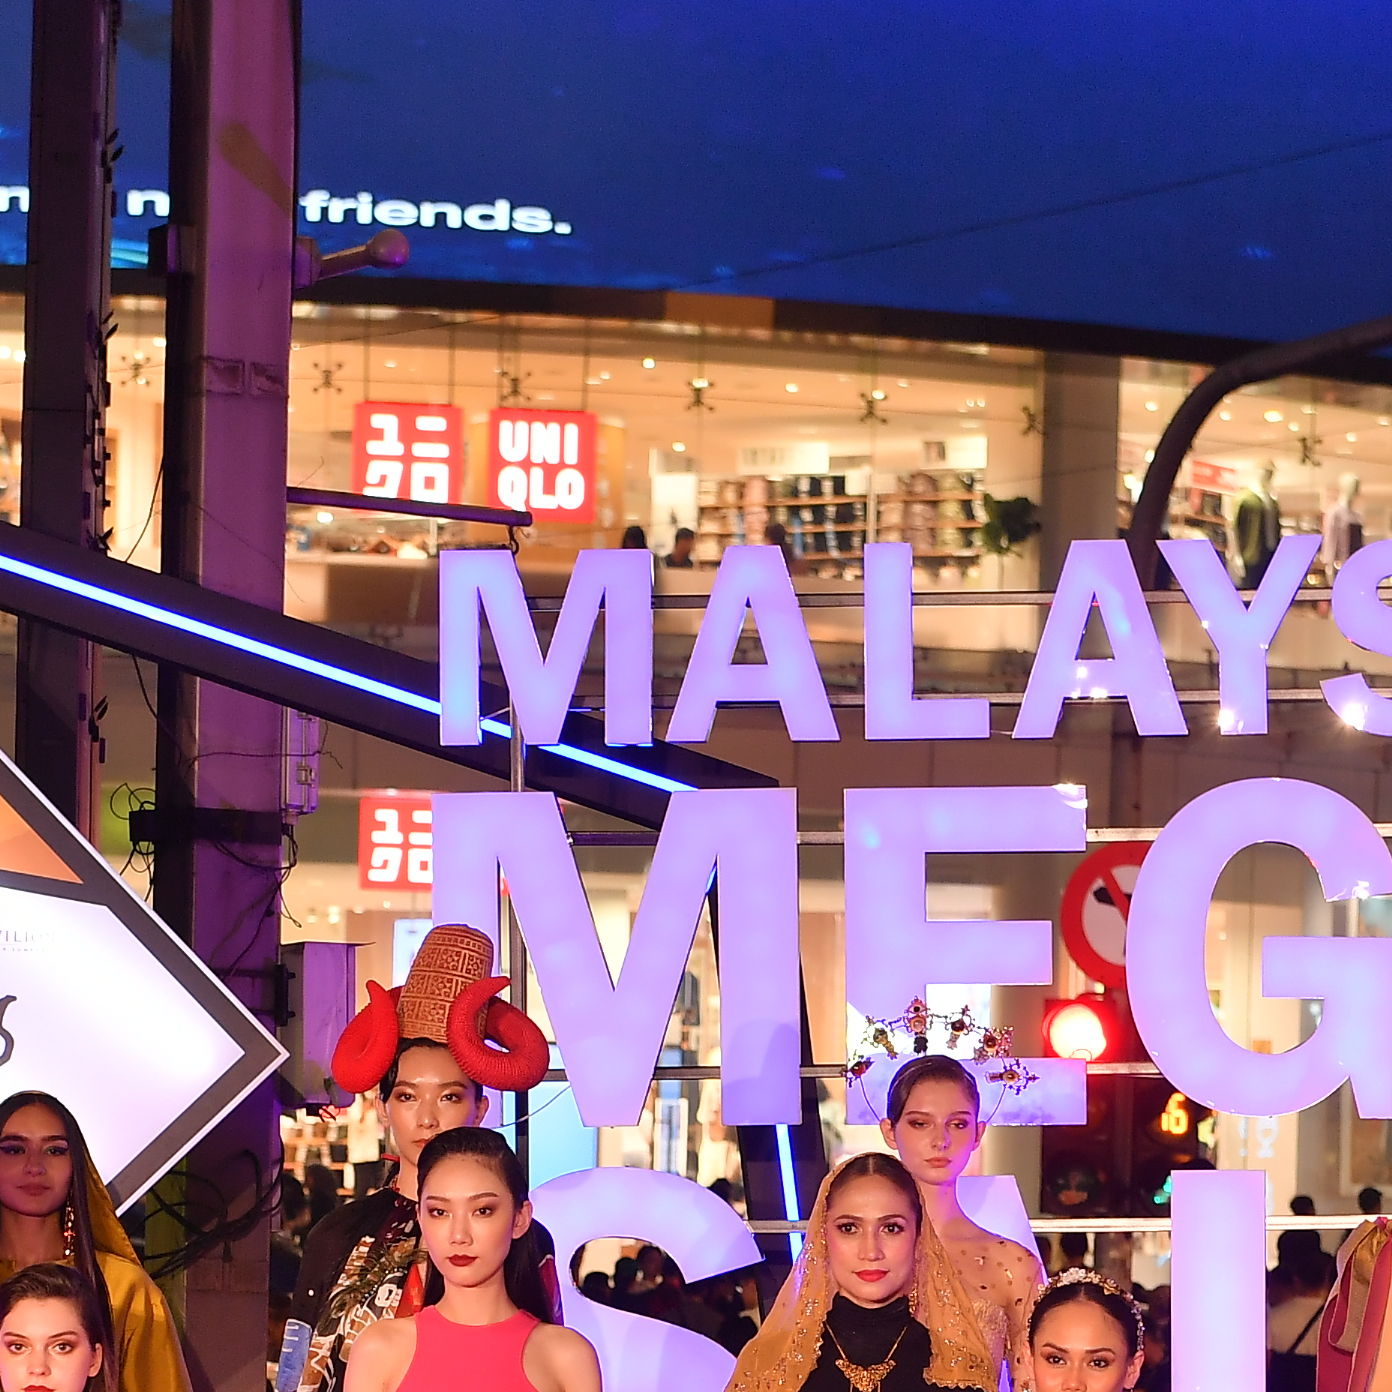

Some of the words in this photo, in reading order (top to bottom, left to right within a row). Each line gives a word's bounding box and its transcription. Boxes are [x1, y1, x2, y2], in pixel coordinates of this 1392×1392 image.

[298, 189, 573, 236] friends.
[498, 419, 580, 466] UNI
[497, 465, 586, 512] QLO
